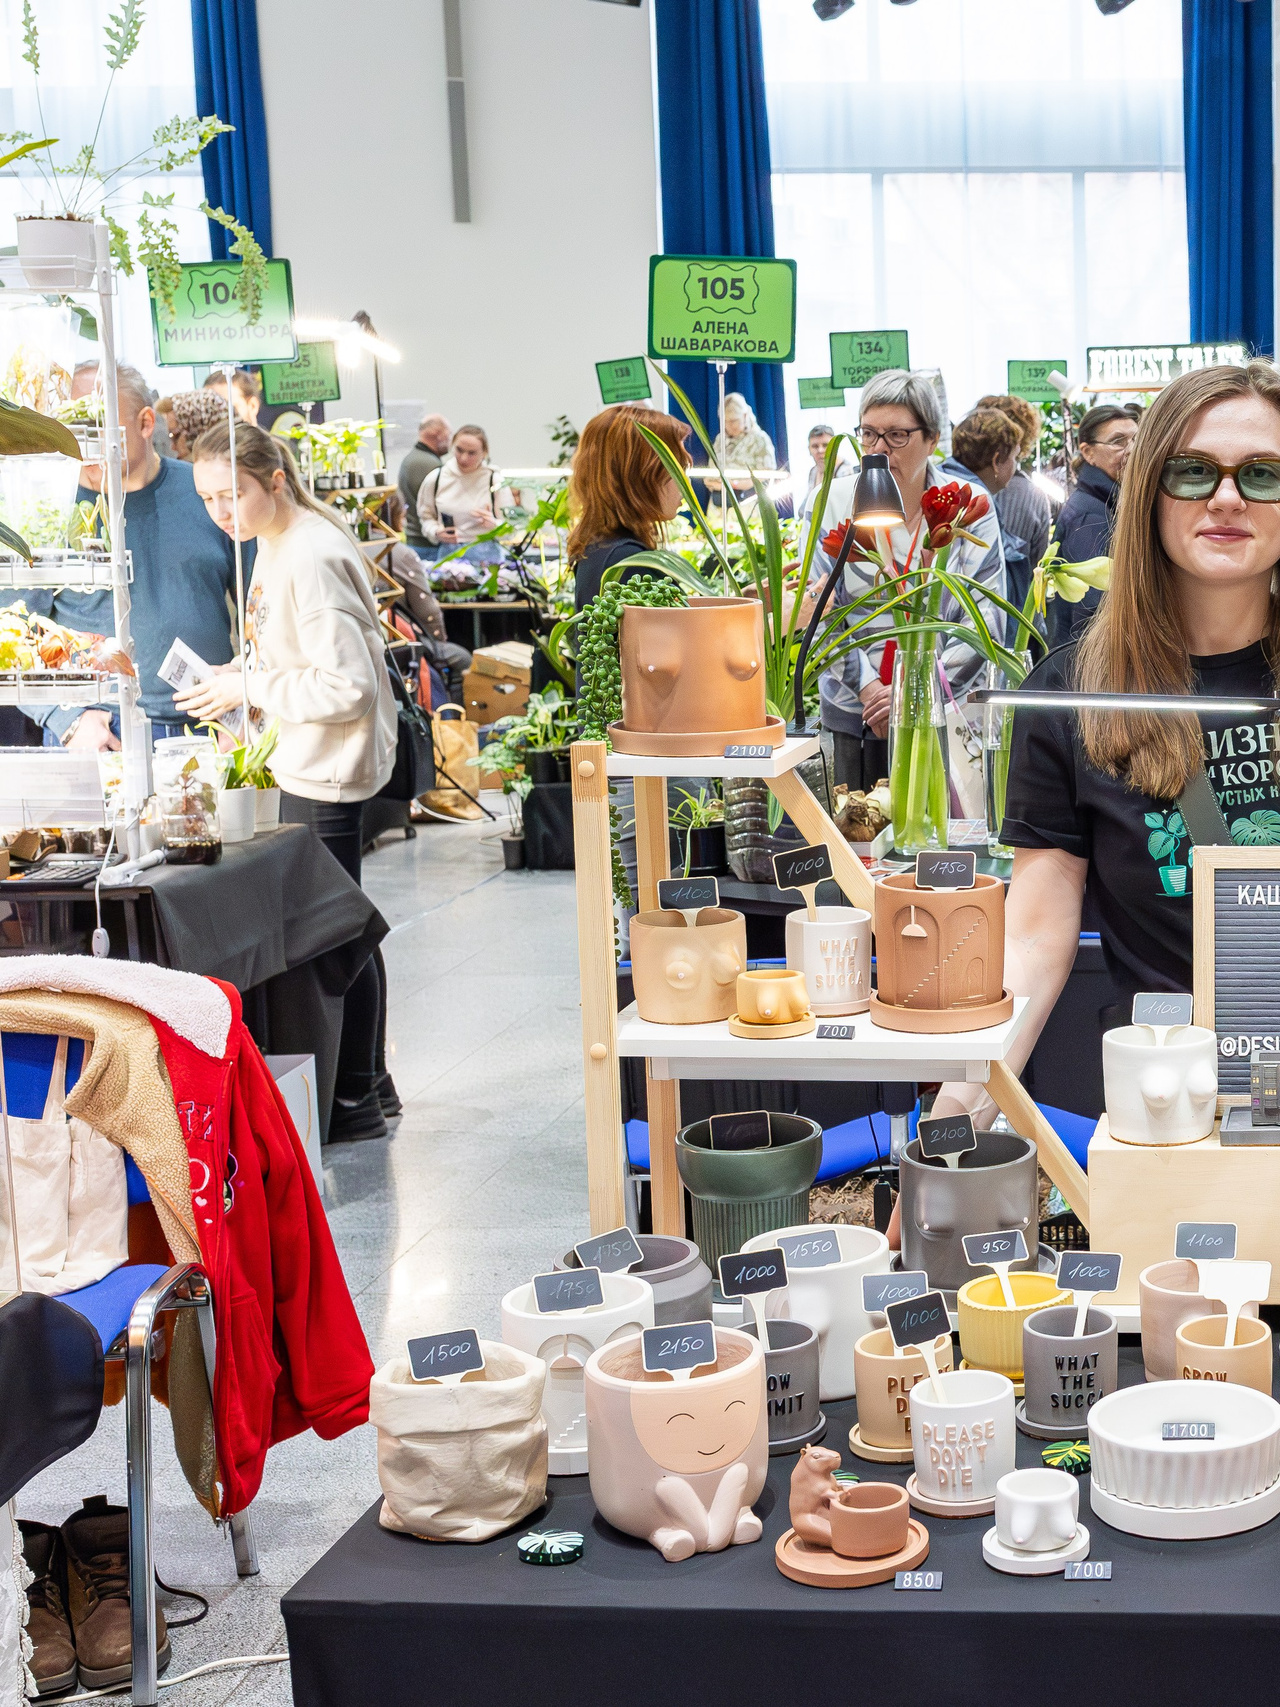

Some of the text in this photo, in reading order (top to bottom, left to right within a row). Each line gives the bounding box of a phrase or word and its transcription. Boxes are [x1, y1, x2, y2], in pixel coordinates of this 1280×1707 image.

[697, 276, 745, 301] 105
[164, 324, 292, 343] МИНИФЛОРА
[692, 320, 749, 335] АЛЕНА
[660, 336, 780, 353] ШАВАРАКОВА
[856, 341, 883, 355] 134
[1026, 367, 1047, 378] 139
[729, 744, 767, 757] 2100
[786, 856, 825, 878] 1000
[929, 861, 967, 875] 1750
[671, 886, 713, 901] 1100
[819, 936, 859, 953] WHAT
[823, 955, 856, 971] THE
[814, 970, 863, 989] SUCCA
[1142, 1000, 1182, 1016] 1100
[822, 1025, 849, 1037] 700
[930, 1125, 967, 1144] 2100
[788, 1239, 833, 1261] 1550
[981, 1239, 1011, 1255] 950
[1186, 1235, 1225, 1248] 1100
[734, 1264, 777, 1284] 1000
[1067, 1260, 1111, 1280] 1000
[876, 1284, 919, 1300] 1000
[900, 1306, 940, 1333] 1000
[421, 1341, 472, 1366] 1500
[657, 1337, 705, 1358] 2150
[1054, 1352, 1100, 1371] WHAT
[1182, 1364, 1228, 1381] GROW
[1060, 1373, 1095, 1390] THE
[921, 1420, 996, 1443] PLEASE
[1169, 1423, 1209, 1437] 1700
[938, 1467, 974, 1487] DIE
[1073, 1563, 1104, 1578] 700
[902, 1572, 934, 1588] 850
